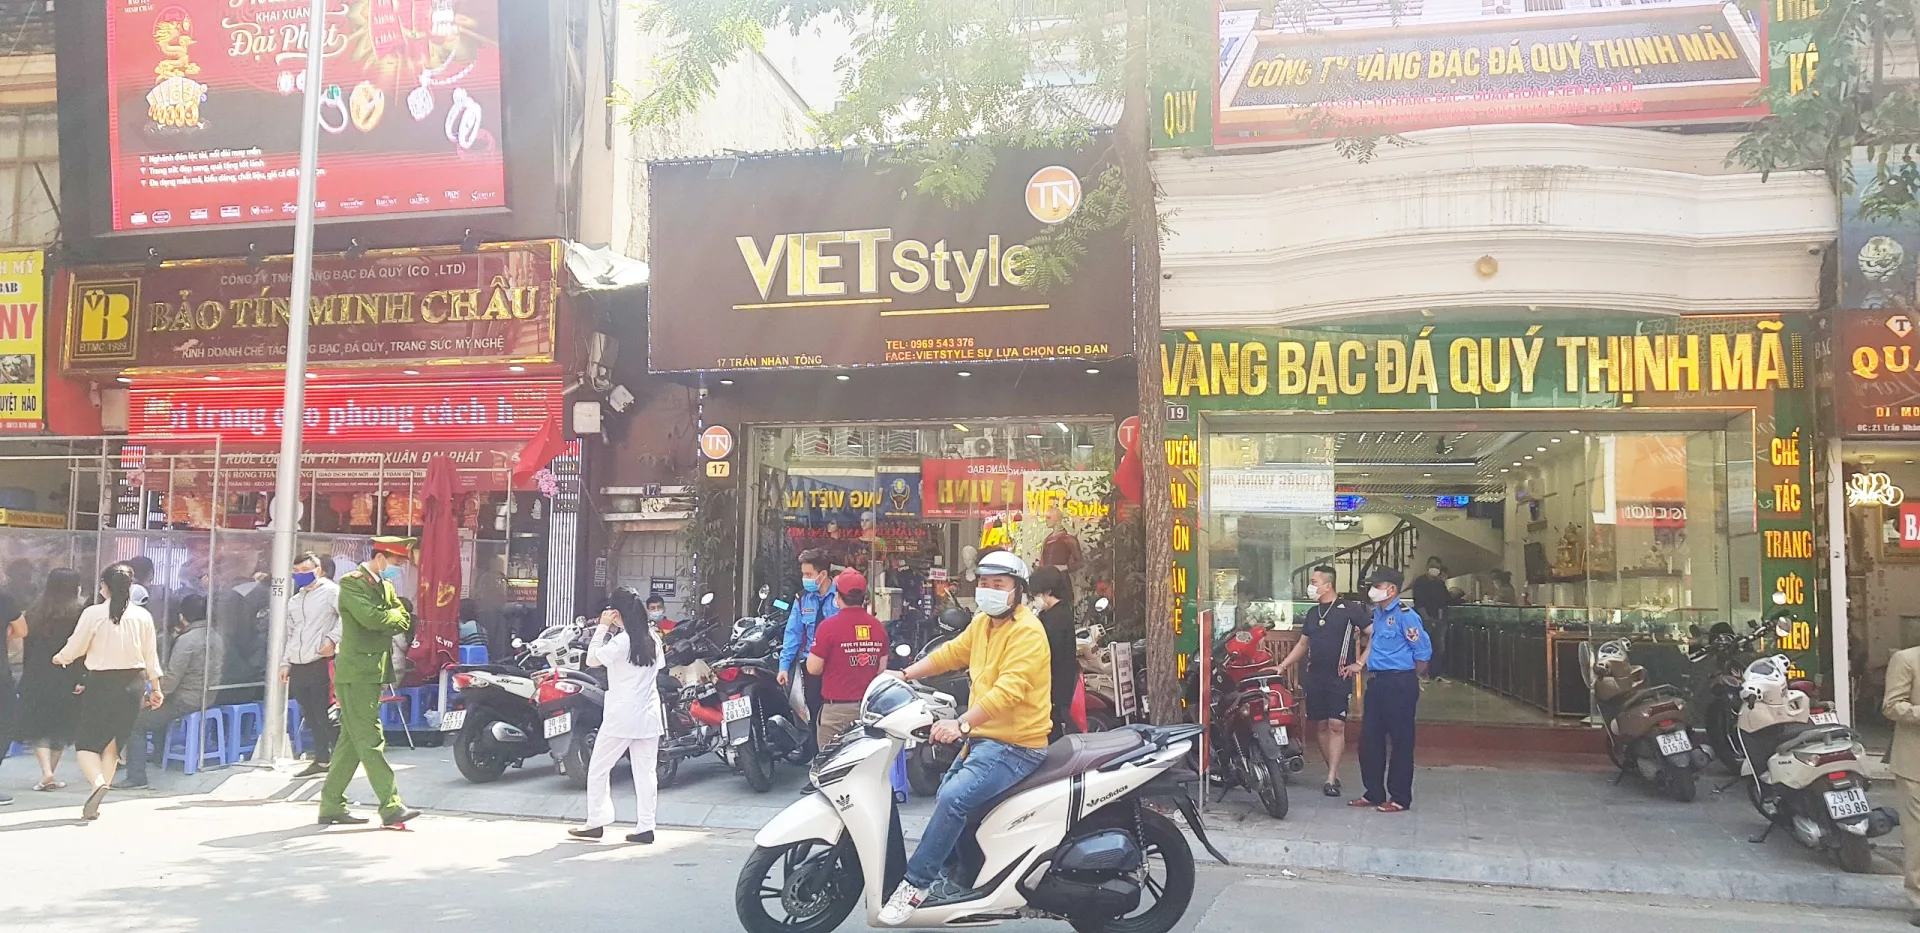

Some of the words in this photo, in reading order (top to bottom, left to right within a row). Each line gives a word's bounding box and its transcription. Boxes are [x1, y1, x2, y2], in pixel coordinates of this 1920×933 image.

[255, 9, 281, 22] KHAI
[283, 6, 311, 20] XUÂN
[226, 28, 278, 60] Đại
[279, 22, 345, 52] Pht
[1356, 48, 1421, 82] VÀNG
[1428, 49, 1480, 83] BẠC
[1488, 39, 1525, 75] ĐÁ
[1531, 35, 1583, 73] QUÝ
[1588, 34, 1679, 75] THỊNH
[1677, 25, 1738, 62] MÃI
[1031, 179, 1075, 209] TN
[220, 271, 252, 286] CÔNG
[333, 268, 356, 281] BẠC
[359, 265, 376, 279] ĐÁ
[735, 227, 893, 301] VIET
[890, 234, 1035, 304] Style
[147, 289, 224, 332] BẢO
[229, 286, 291, 329] TÍN
[308, 291, 415, 327] MINH
[420, 275, 540, 325] CHÂU
[1895, 319, 1906, 332] T
[79, 342, 105, 352] BTMC
[182, 346, 205, 359] KINH
[207, 345, 242, 358] DOANH
[244, 342, 265, 356] CHẾ
[344, 340, 363, 353] ĐÁ
[390, 340, 426, 352] TRANG
[429, 337, 452, 350] SỨC
[455, 335, 473, 349] MỸ
[473, 334, 505, 350] NGHỆ
[886, 339, 909, 350] TEL:
[910, 338, 934, 349] 0969
[936, 337, 955, 348] 543
[956, 336, 975, 348] 376
[977, 347, 993, 360] SỰ
[1022, 345, 1054, 358] CHỌN
[1057, 344, 1081, 356] CHO
[1084, 343, 1108, 359] BẠN
[716, 358, 726, 368] 17
[761, 354, 789, 367] NHÂN
[794, 353, 823, 366] TÔNG
[1160, 330, 1268, 397] VÀNG
[1278, 340, 1367, 406] BẠC
[1375, 325, 1440, 395] ĐÁ
[1449, 324, 1545, 396] QUÝ
[1556, 334, 1700, 404] THỊNH
[1710, 320, 1805, 390] MÃI
[22, 388, 37, 411] HẢO
[195, 404, 267, 435] trang
[273, 406, 320, 428] co
[328, 400, 415, 435] phong
[422, 397, 487, 425] cách
[1169, 407, 1184, 419] 19
[705, 433, 730, 451] TN
[1771, 427, 1800, 466] CHẾ
[384, 448, 418, 464] XUÂN
[711, 463, 725, 475] 17
[644, 484, 658, 496] 17
[1773, 479, 1801, 512] TÁC
[1764, 530, 1813, 559] TRANG
[272, 587, 284, 597] 55
[1775, 572, 1805, 605] SỨC
[1100, 784, 1129, 803] adidas
[1831, 800, 1869, 817] 799.86
